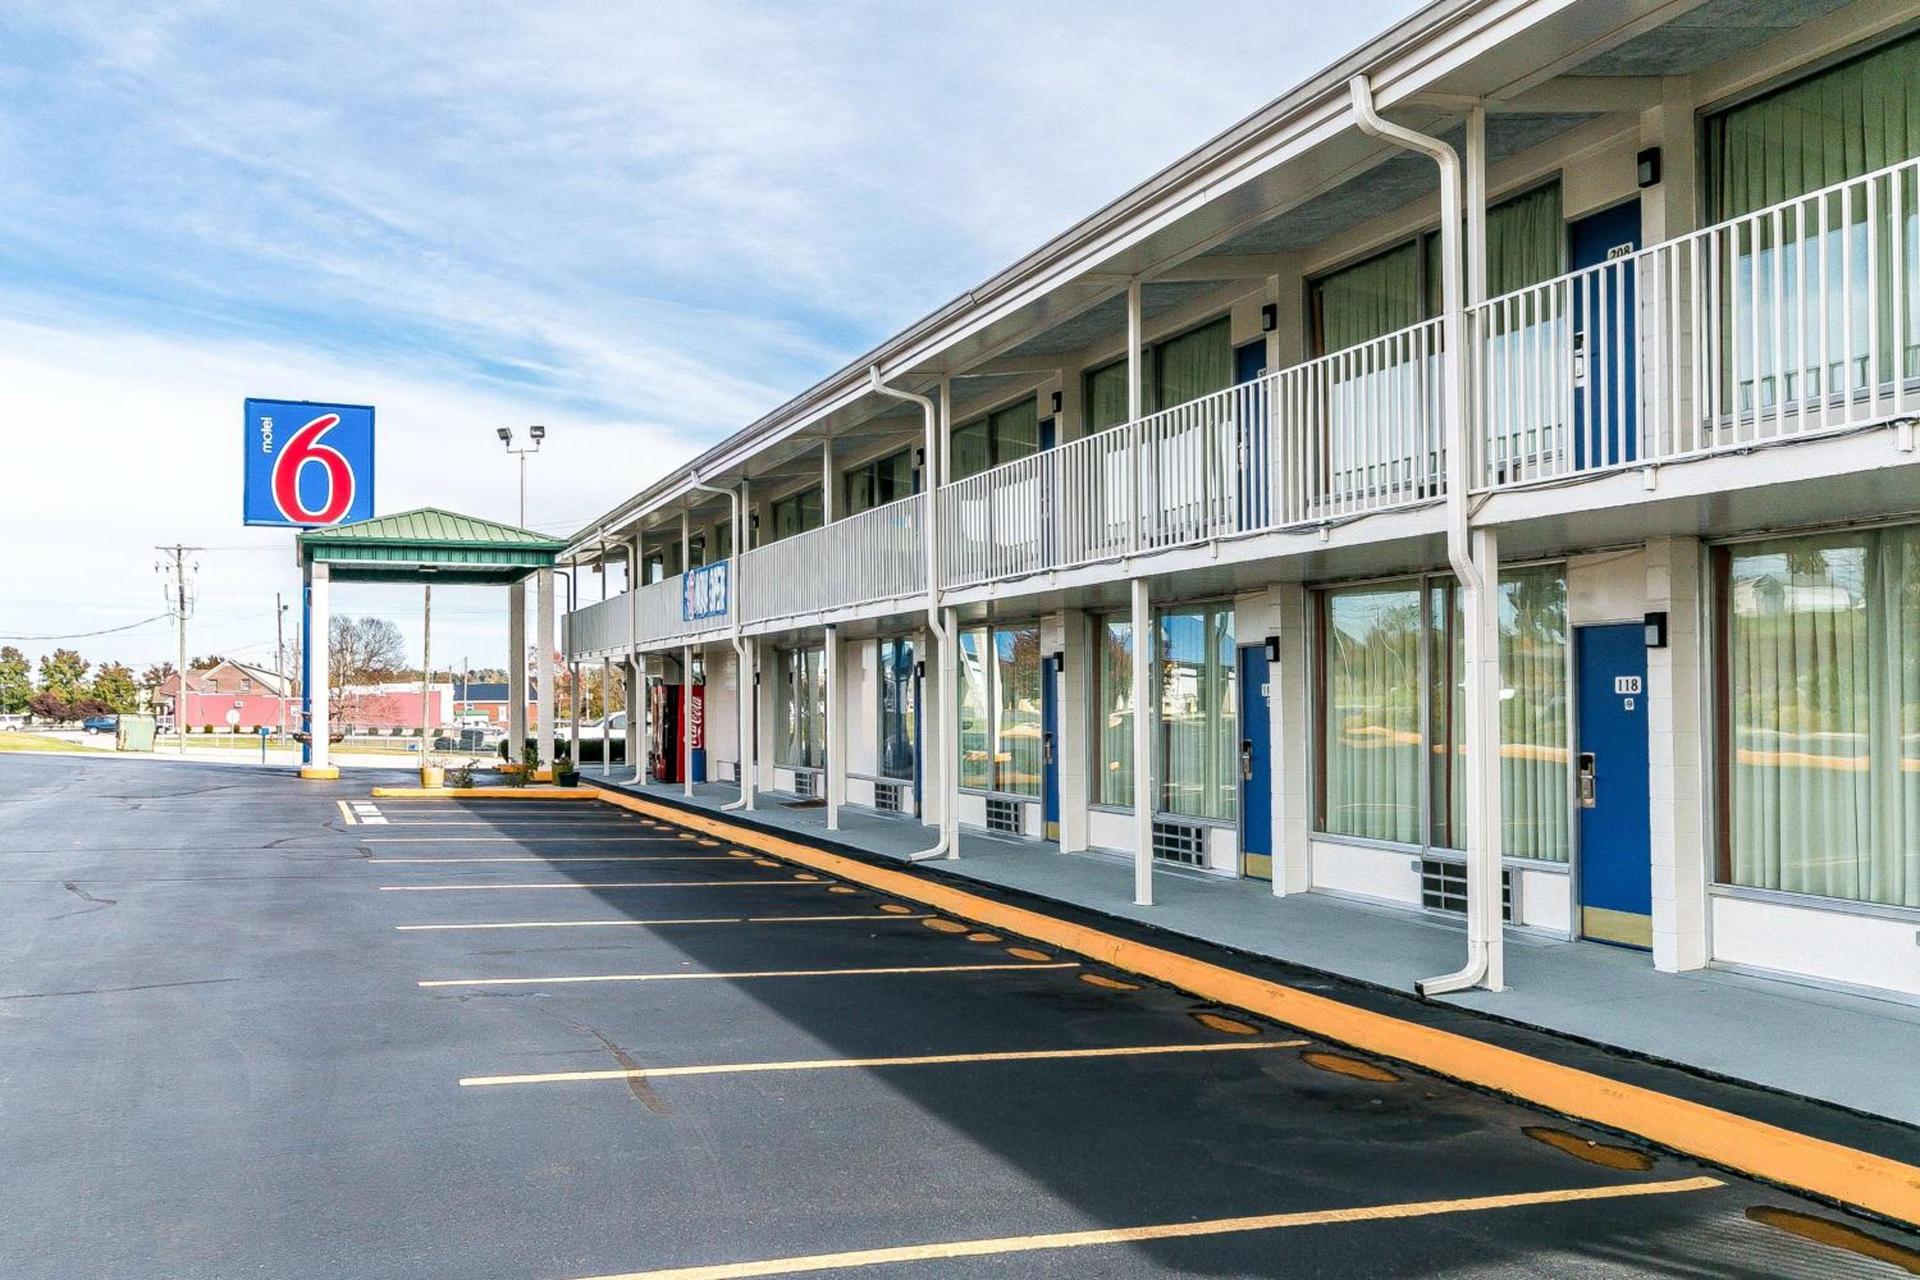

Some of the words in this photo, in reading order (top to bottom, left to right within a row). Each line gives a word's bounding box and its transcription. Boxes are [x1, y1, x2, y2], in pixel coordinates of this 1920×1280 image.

[1610, 245, 1630, 259] 208
[260, 416, 273, 453] motel
[271, 413, 355, 525] 6
[1617, 679, 1638, 692] 118
